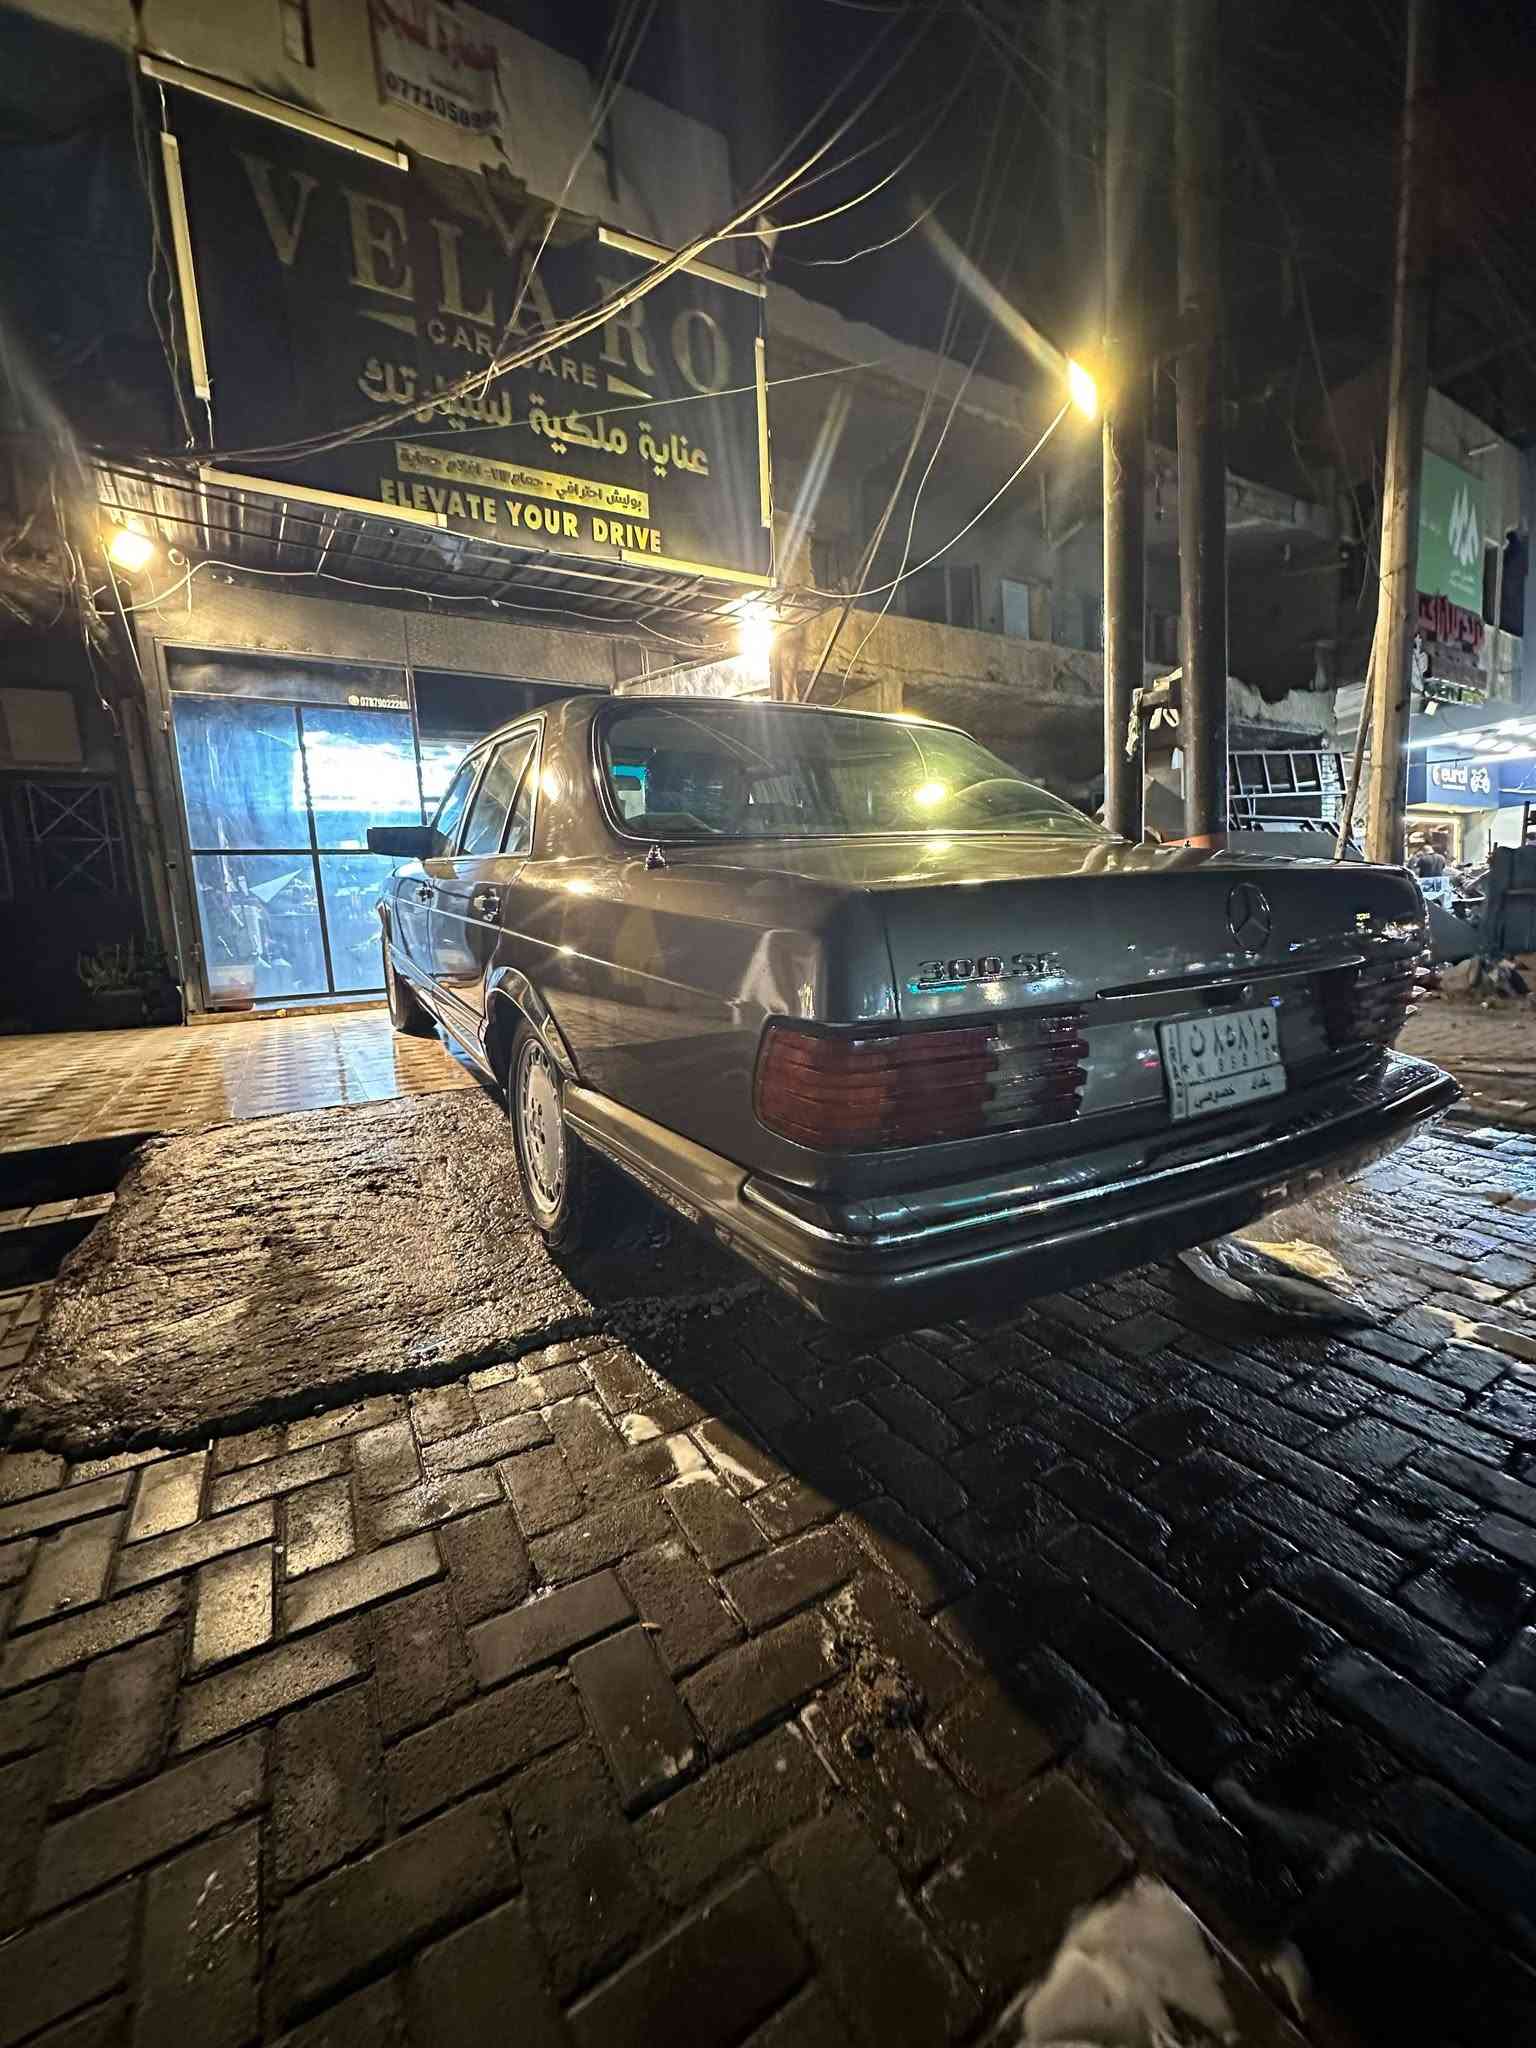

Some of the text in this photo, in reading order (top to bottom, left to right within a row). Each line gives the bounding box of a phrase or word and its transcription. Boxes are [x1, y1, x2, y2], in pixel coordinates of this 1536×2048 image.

[240, 152, 729, 394] VELARO
[427, 319, 598, 389] CAR ARE
[529, 392, 629, 455] ملكية
[638, 420, 710, 478] عناية
[379, 478, 662, 553] ELEVATE YOUR DRIVE
[556, 480, 603, 500] احترافي
[605, 488, 643, 512] بوليش
[918, 952, 1065, 982] 300 SE
